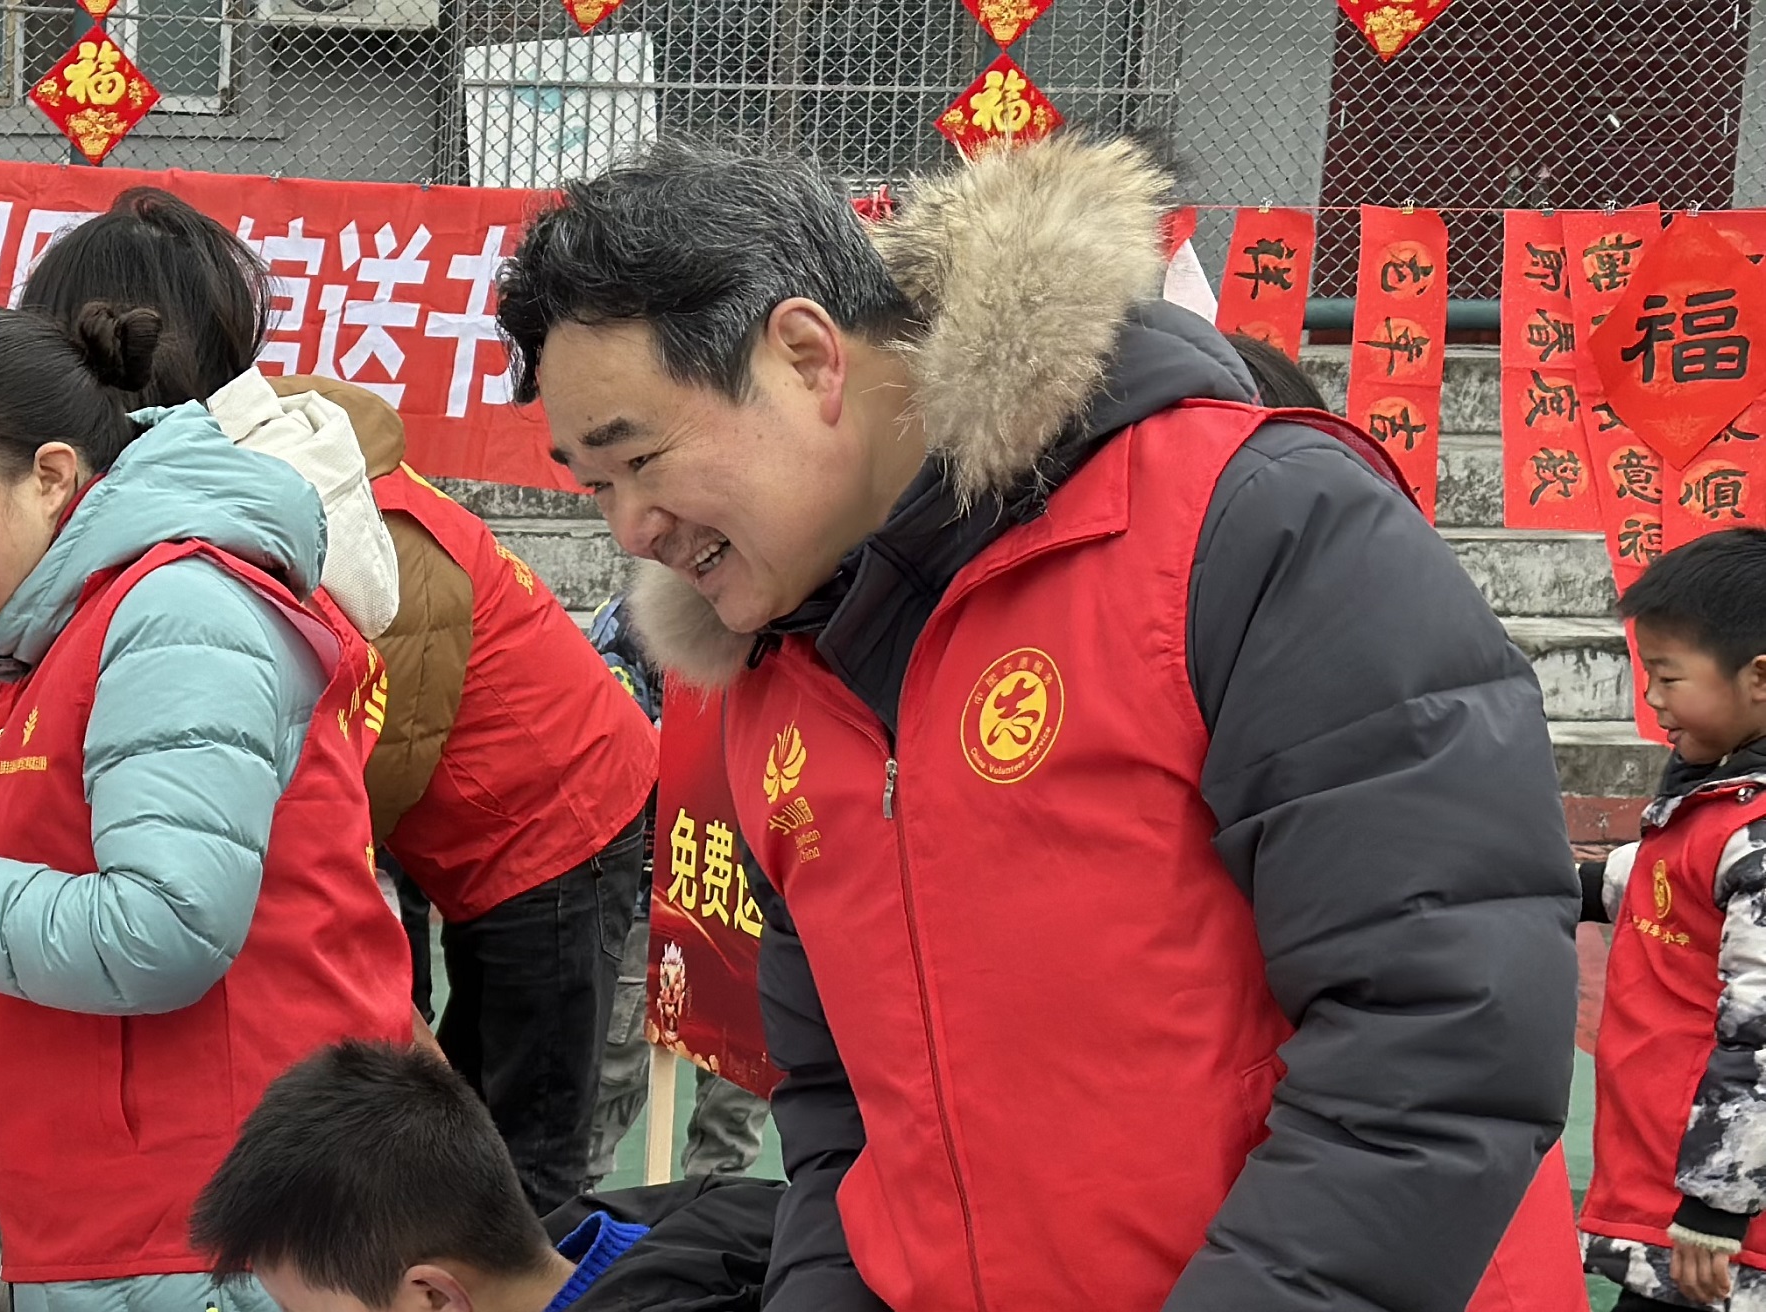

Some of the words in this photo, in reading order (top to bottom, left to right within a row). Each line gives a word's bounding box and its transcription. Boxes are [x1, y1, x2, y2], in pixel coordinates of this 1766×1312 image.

[63, 40, 126, 106] 福
[969, 69, 1032, 133] 福
[1621, 288, 1751, 384] 福
